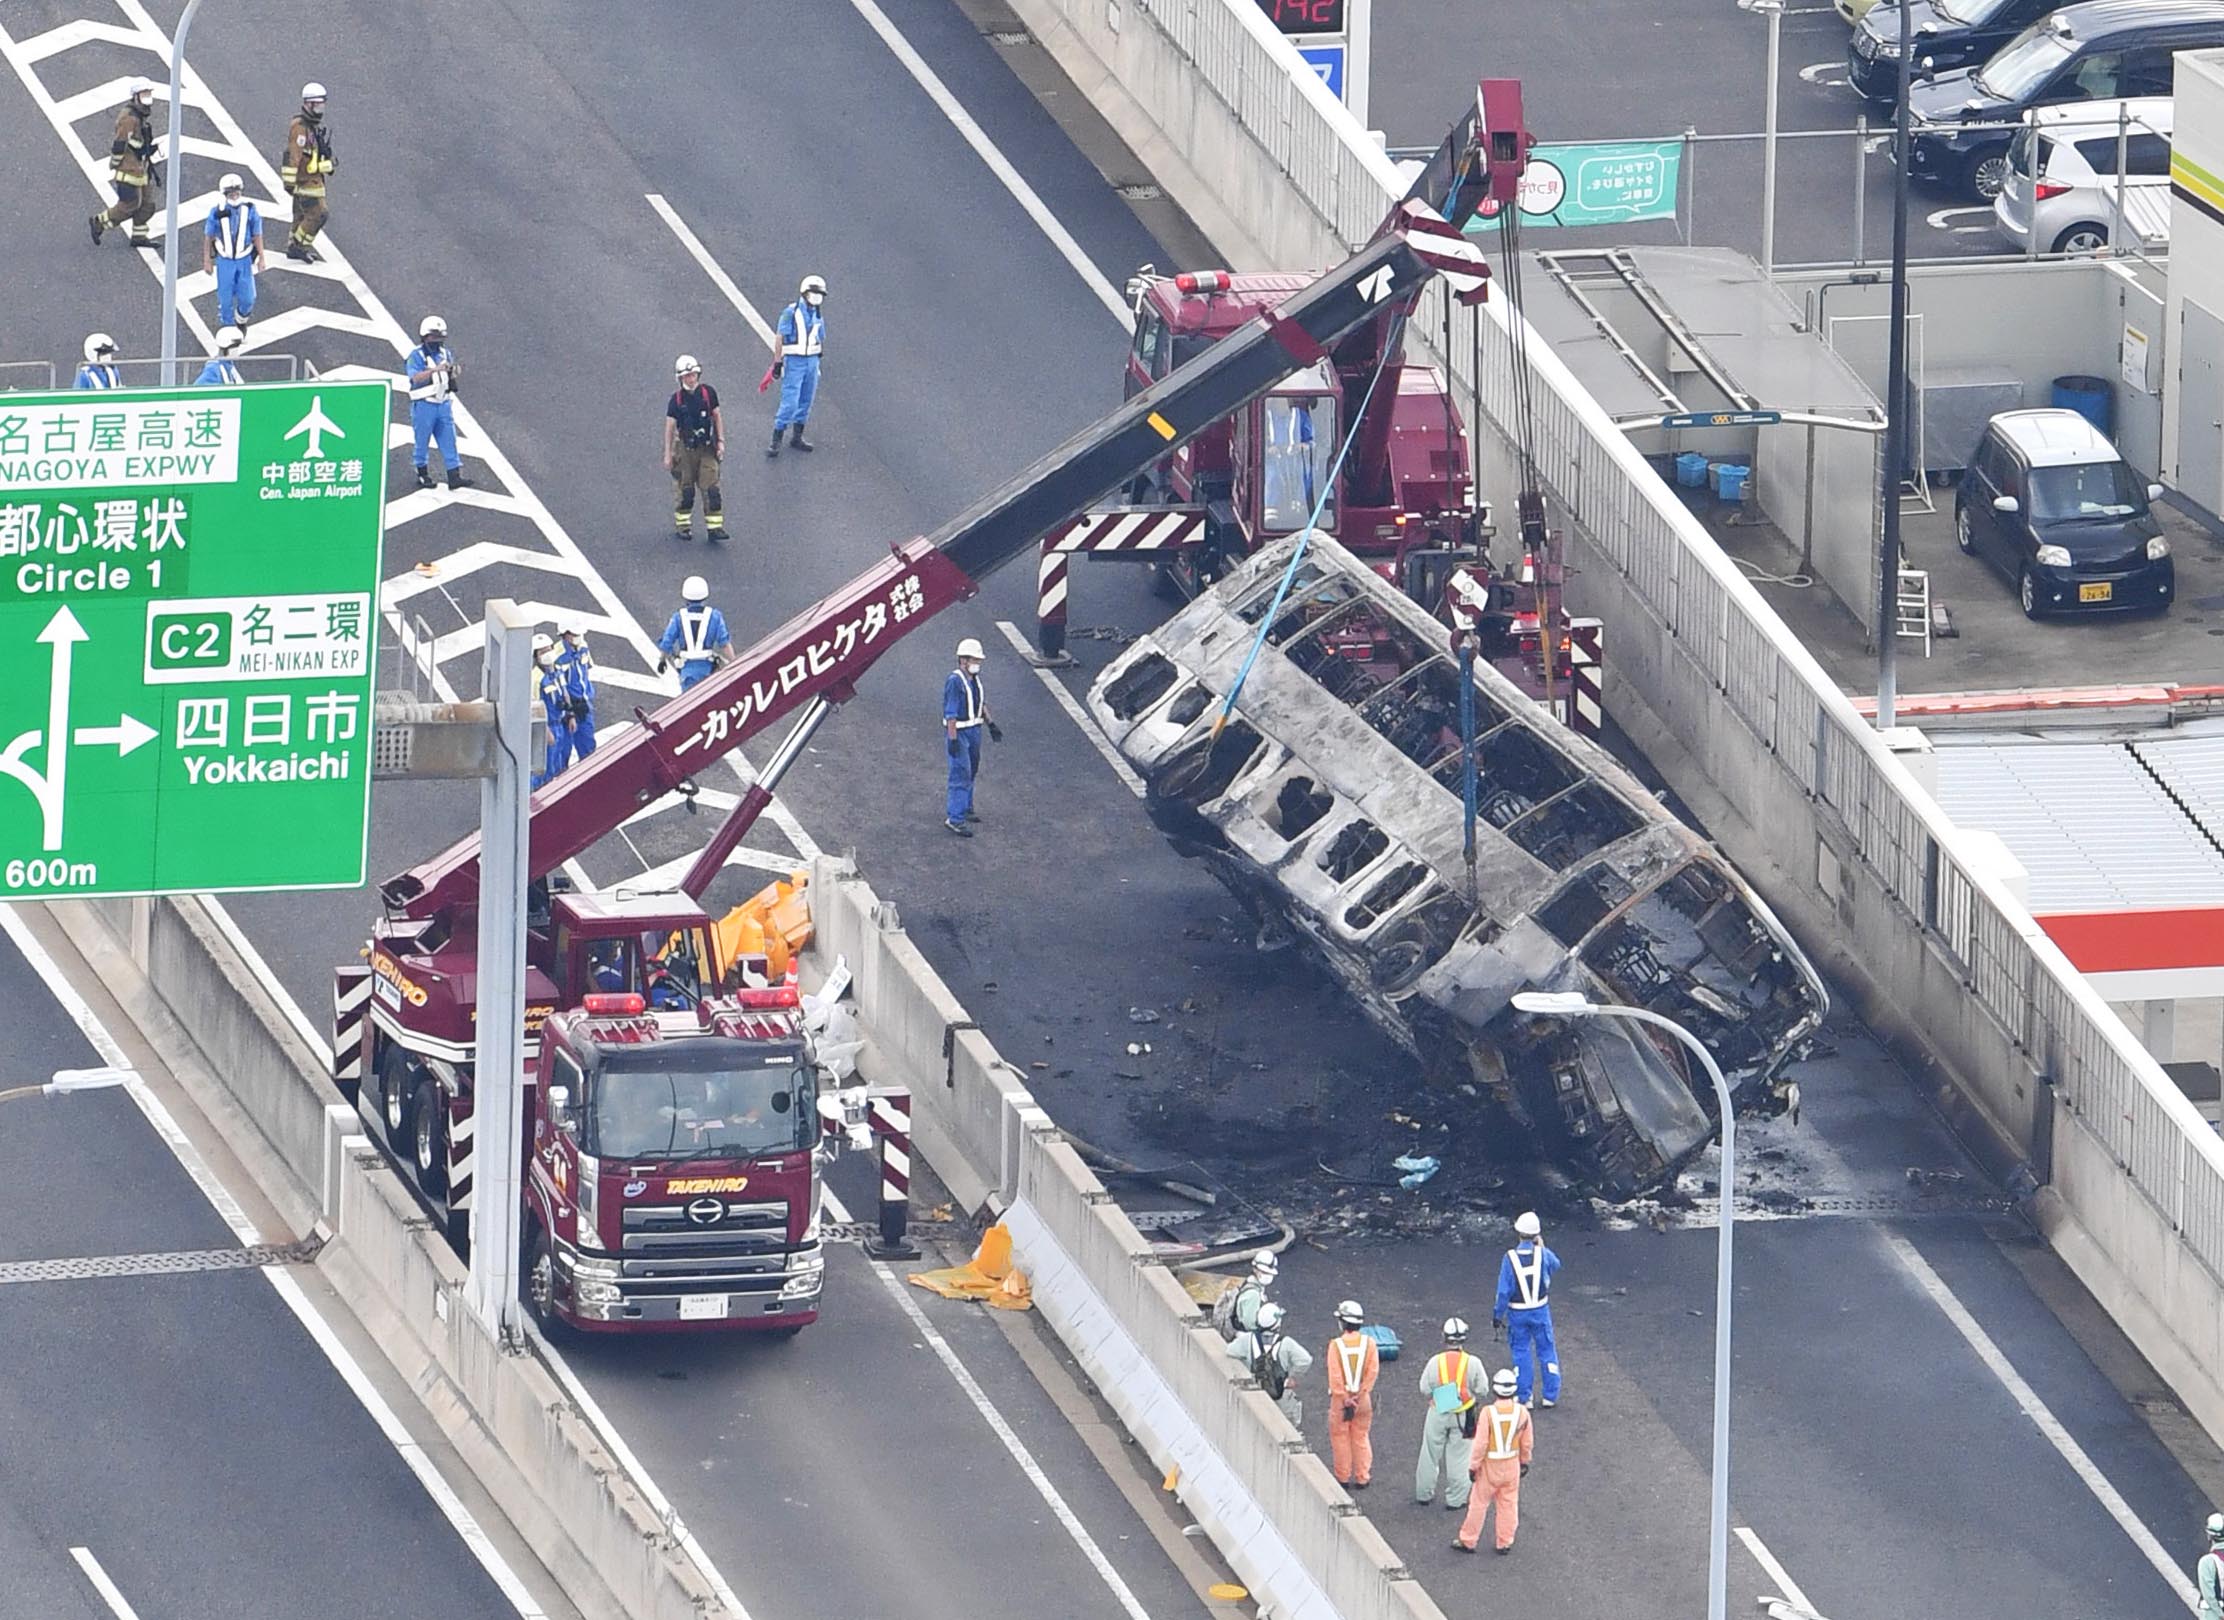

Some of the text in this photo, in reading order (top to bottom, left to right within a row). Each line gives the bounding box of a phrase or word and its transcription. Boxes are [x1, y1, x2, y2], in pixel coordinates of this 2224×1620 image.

[0, 408, 222, 455] 名古屋高速
[0, 454, 215, 482] NAGOYA EXPWY
[262, 460, 363, 485] 中部空港
[260, 484, 362, 501] Cen. Japan Airport
[0, 498, 187, 557] 都心環状
[16, 559, 161, 593] Circle 1
[161, 622, 220, 659] C2
[242, 601, 361, 646] 名二環
[239, 649, 359, 673] MEI-NIKAN EXP
[176, 690, 361, 749] 四日市
[183, 750, 349, 784] Yokkaichi
[6, 858, 97, 888] 600m
[667, 1177, 748, 1195] TAKEHIRO
